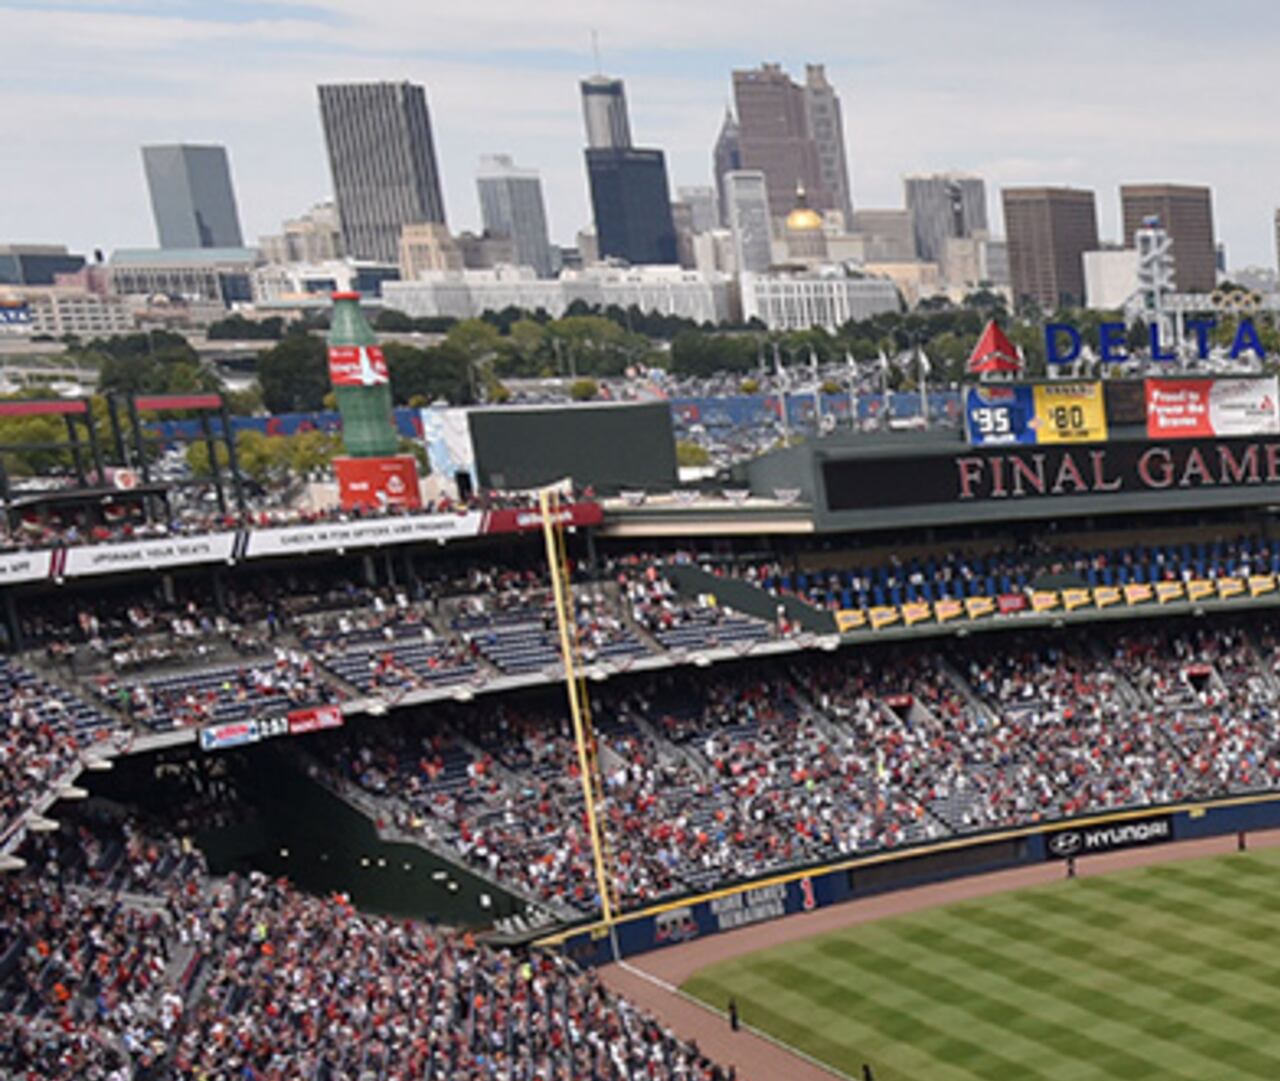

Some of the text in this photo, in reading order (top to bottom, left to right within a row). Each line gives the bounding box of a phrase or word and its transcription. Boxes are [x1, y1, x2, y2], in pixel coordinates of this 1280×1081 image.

[1045, 319, 1266, 365] DELTA
[956, 451, 1122, 499] FINAL
[1085, 821, 1168, 848] HYUNDAI
[801, 876, 815, 909] 1
